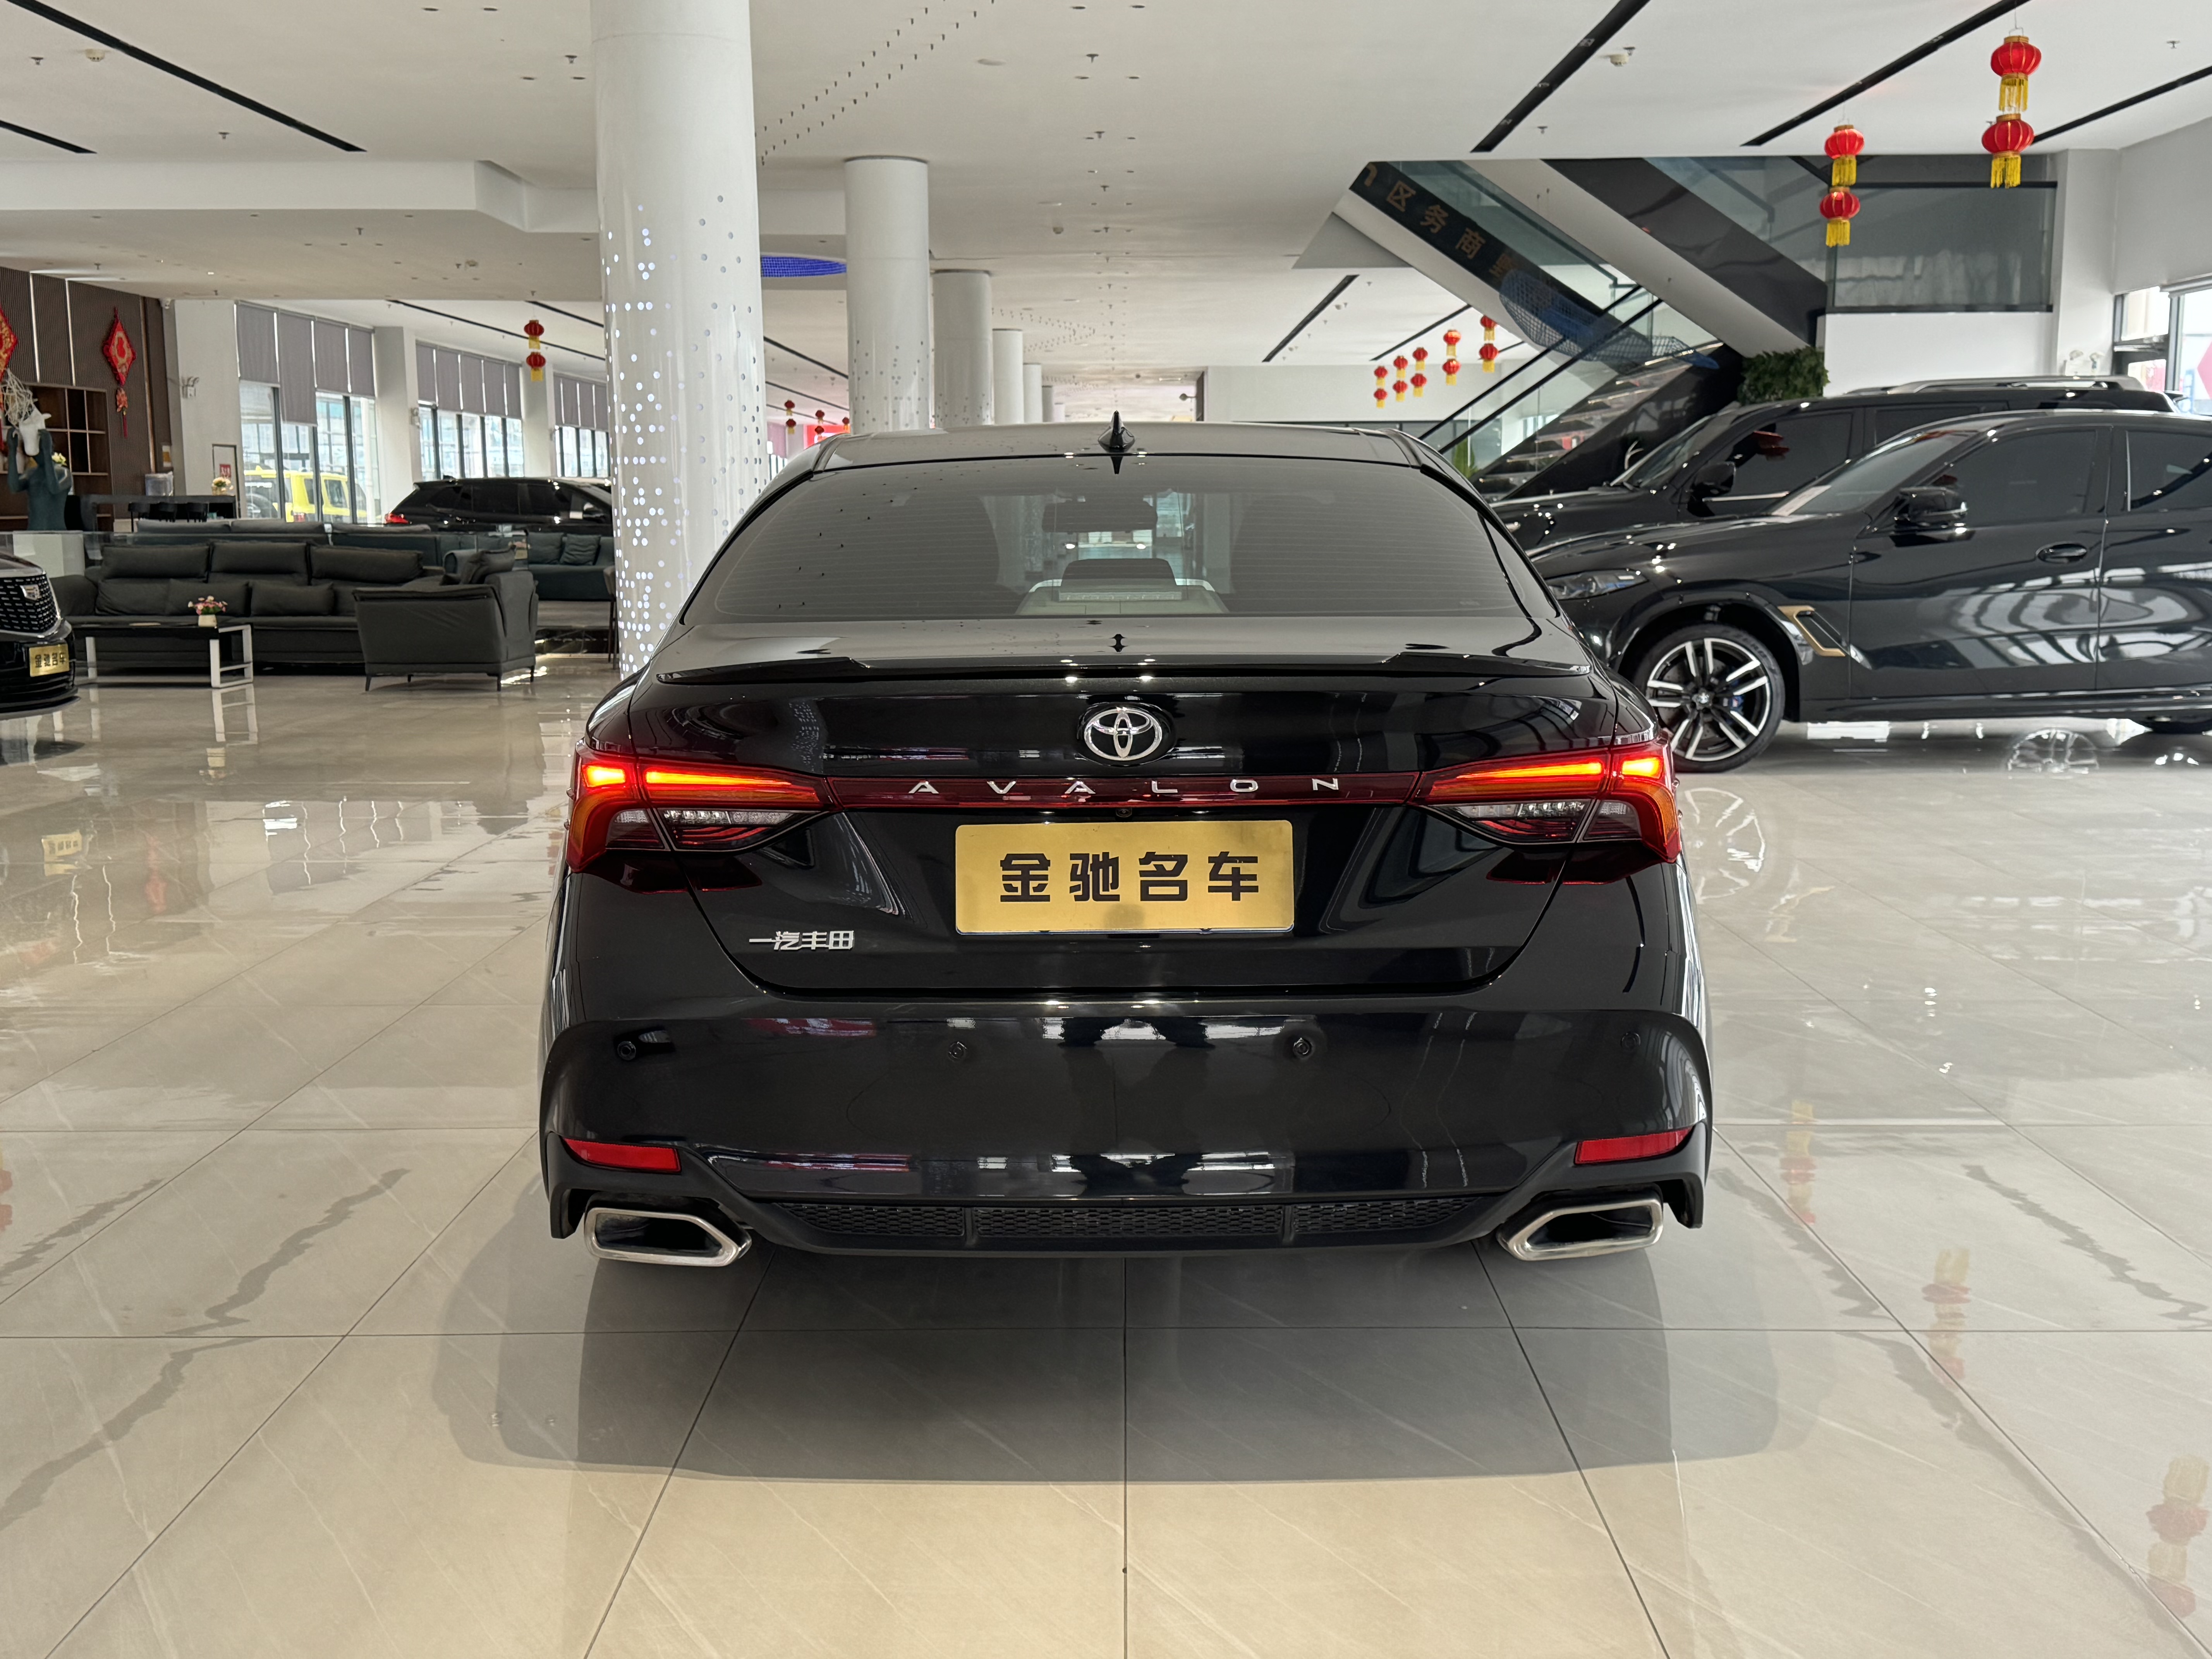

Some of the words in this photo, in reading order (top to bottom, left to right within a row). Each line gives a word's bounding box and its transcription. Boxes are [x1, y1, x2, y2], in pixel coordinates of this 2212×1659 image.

[908, 778, 1339, 794] AVALON
[1000, 852, 1259, 902] 金驰名车
[749, 931, 854, 950] 一汽丰田
